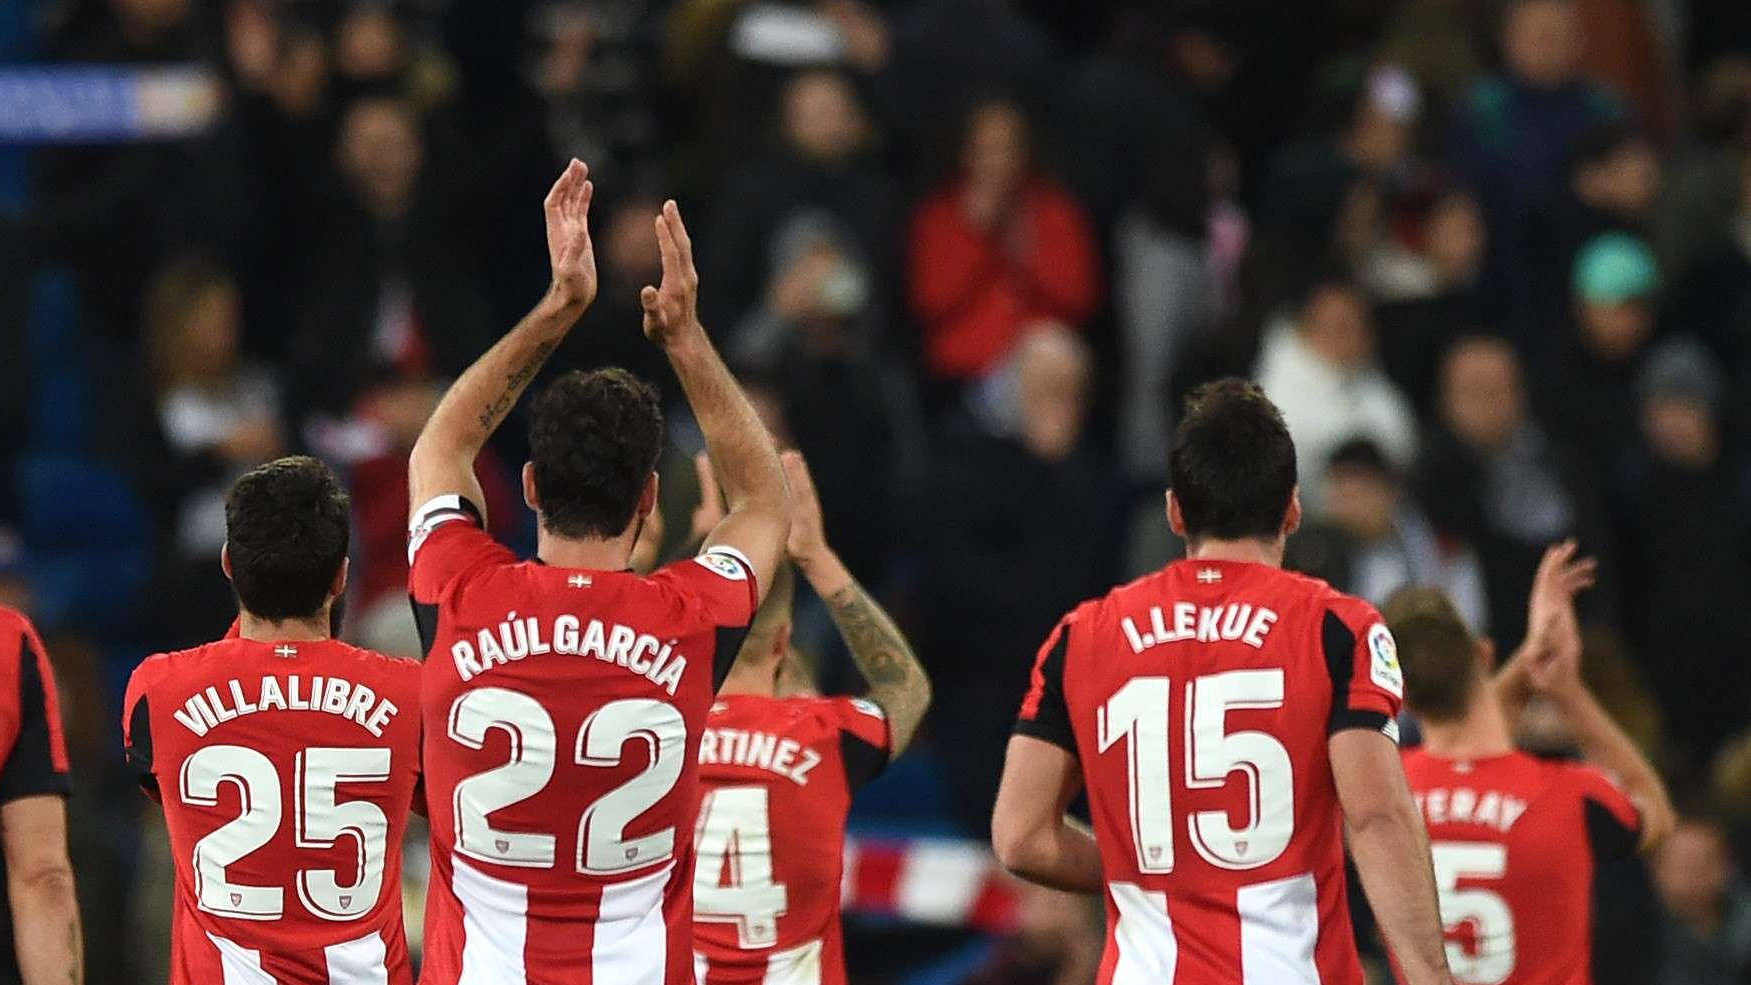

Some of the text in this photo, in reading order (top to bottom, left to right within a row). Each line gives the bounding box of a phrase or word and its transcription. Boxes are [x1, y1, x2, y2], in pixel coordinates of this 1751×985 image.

[174, 675, 399, 738] VILLALIBRE
[451, 611, 687, 696] RAÚL GARCÍA
[1122, 601, 1279, 655] I.LEKUE
[179, 745, 392, 922] 25
[447, 687, 687, 876] 22
[1097, 668, 1294, 875] 15
[692, 787, 787, 949] 4
